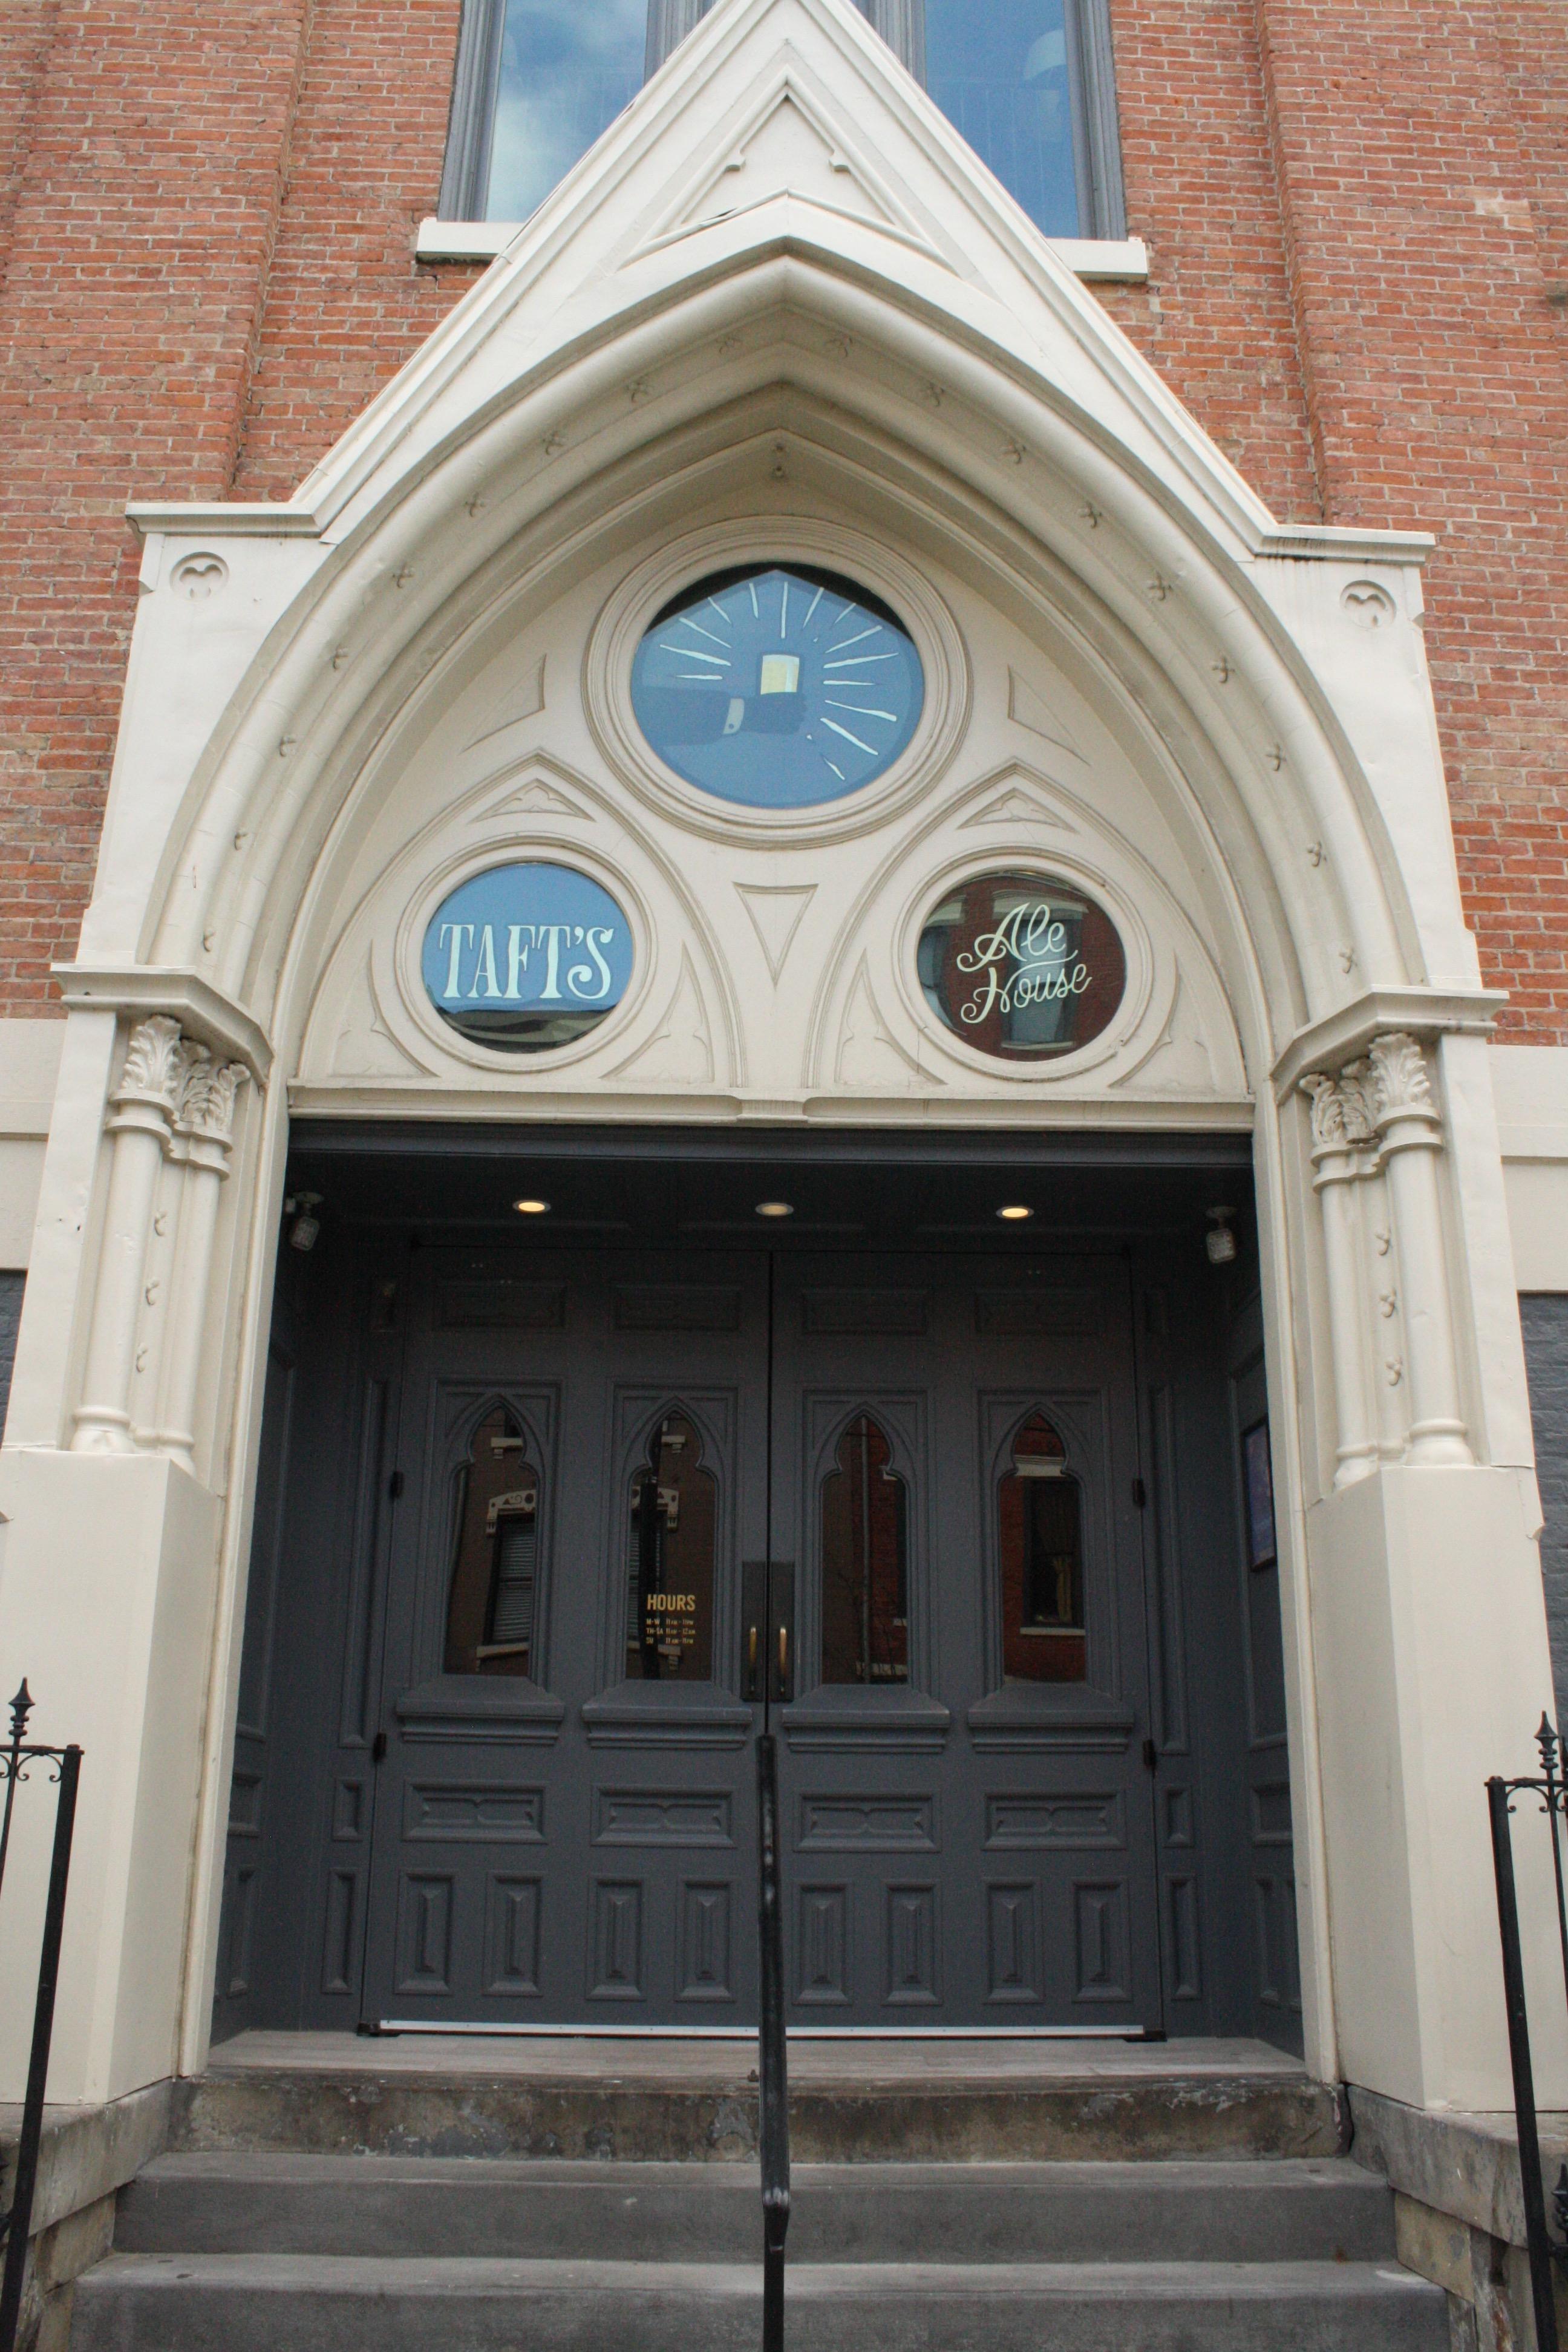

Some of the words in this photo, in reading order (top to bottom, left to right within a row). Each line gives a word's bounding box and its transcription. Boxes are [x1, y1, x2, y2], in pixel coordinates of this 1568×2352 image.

[440, 923, 614, 999] TAFT'S
[956, 902, 1067, 972] Ale
[961, 950, 1093, 1024] House
[647, 1593, 696, 1611] HOURS
